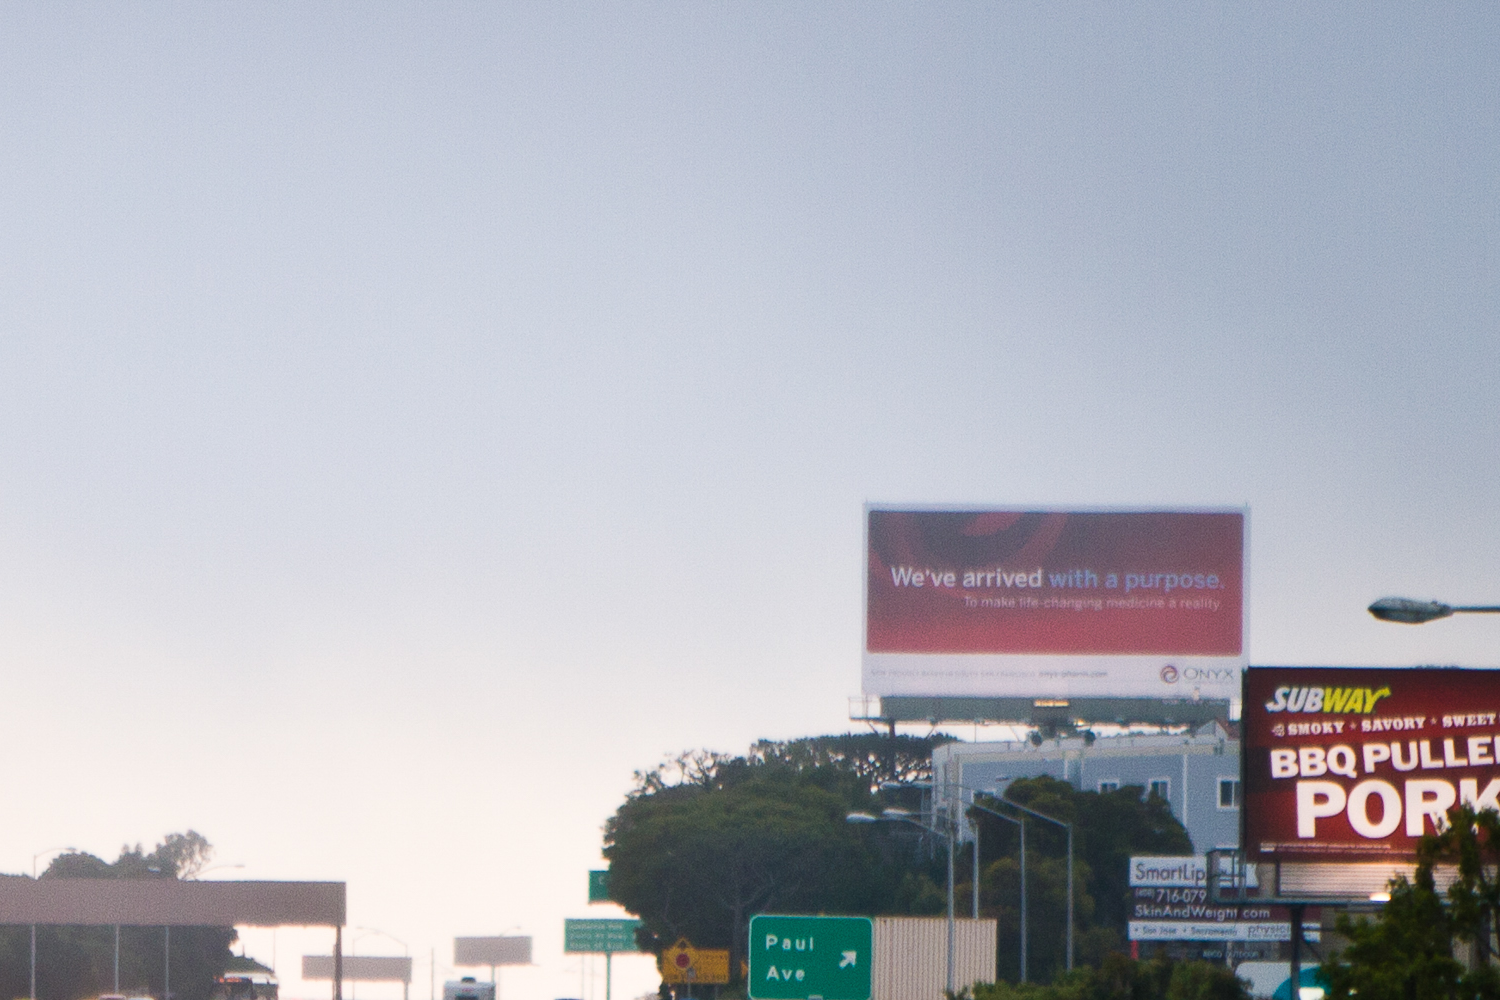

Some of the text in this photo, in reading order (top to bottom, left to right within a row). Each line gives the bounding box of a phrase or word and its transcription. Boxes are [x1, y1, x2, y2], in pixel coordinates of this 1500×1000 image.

[890, 566, 1225, 593] We've arrived with a purpose.
[964, 596, 978, 608] To
[980, 596, 1017, 608] make
[1018, 596, 1102, 612] life-changing
[1106, 597, 1166, 610] medicine
[1180, 598, 1220, 613] reality
[1183, 667, 1234, 680] ONYX
[1265, 687, 1391, 714] SUBWAY
[1287, 711, 1497, 737] SMOKY SAVORY SWEET
[1270, 735, 1500, 779] BBQ PULLE
[1135, 862, 1206, 887] SmartLip
[1156, 888, 1207, 904] 716-079
[1134, 903, 1271, 922] SkinAndWeightcom
[765, 933, 814, 952] Paul
[766, 965, 805, 981] Ave
